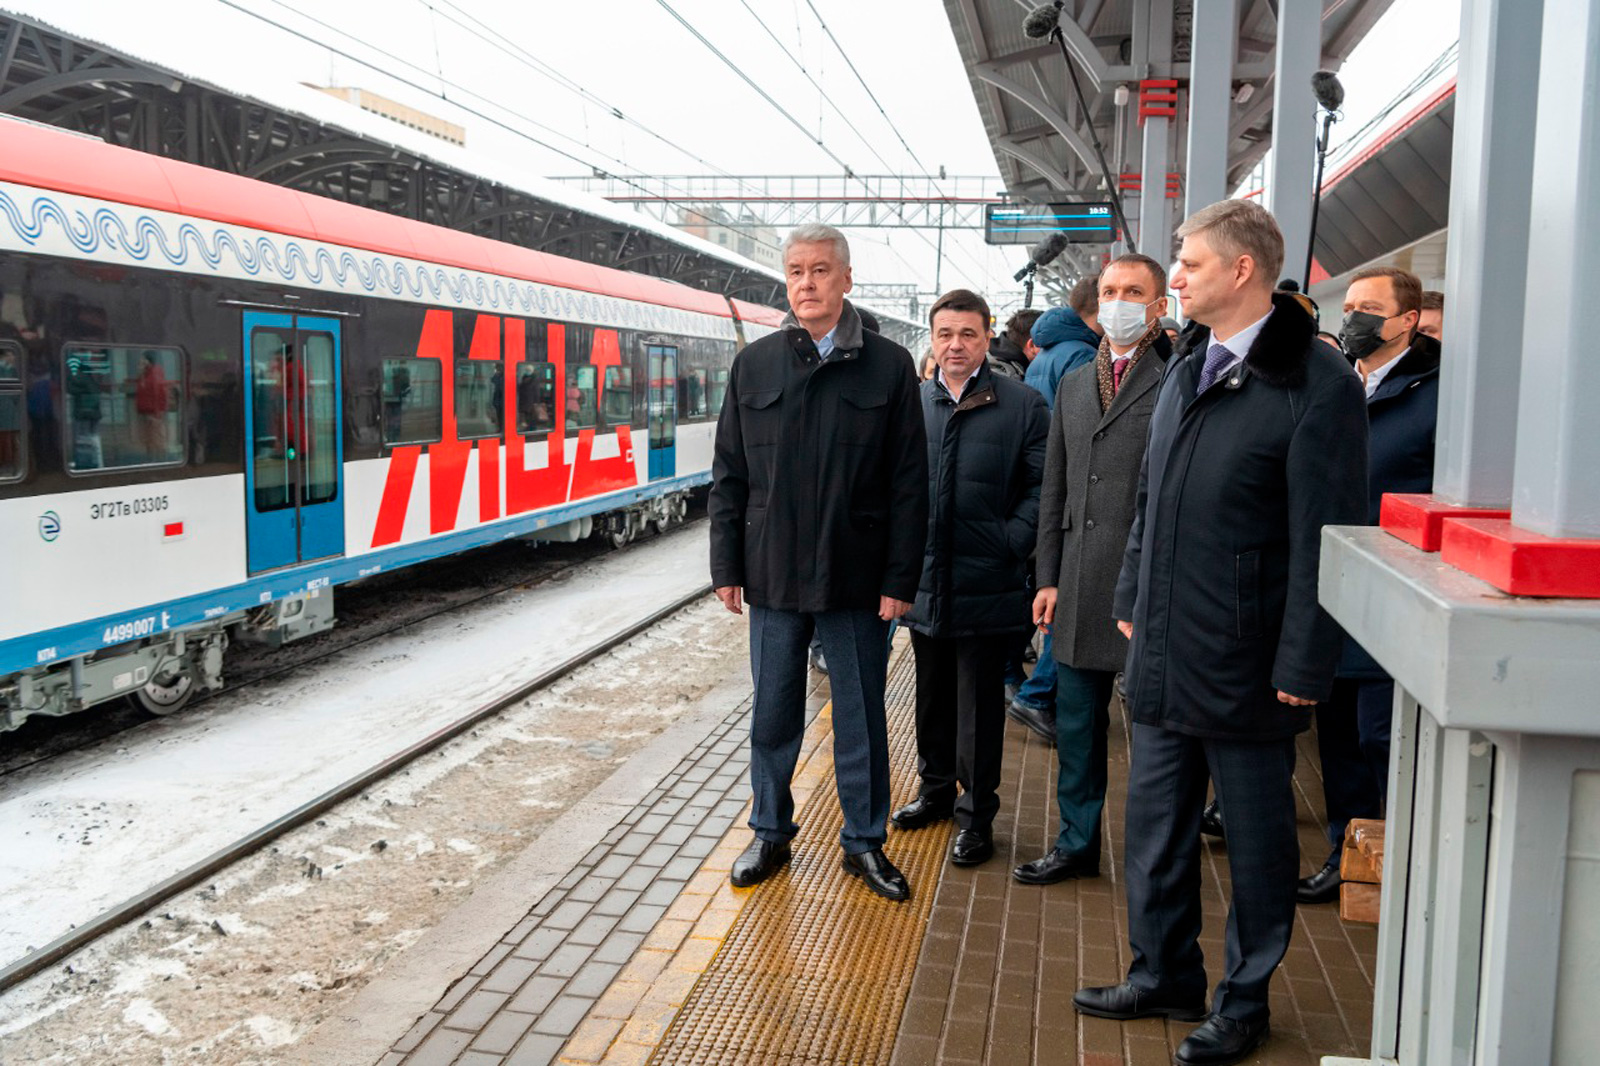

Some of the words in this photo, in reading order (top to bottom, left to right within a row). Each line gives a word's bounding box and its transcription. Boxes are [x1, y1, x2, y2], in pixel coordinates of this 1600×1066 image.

[370, 309, 638, 549] МЦД
[90, 501, 131, 520] ЭГ2Тв
[133, 495, 169, 515] 03305
[103, 616, 156, 644] 4499007
